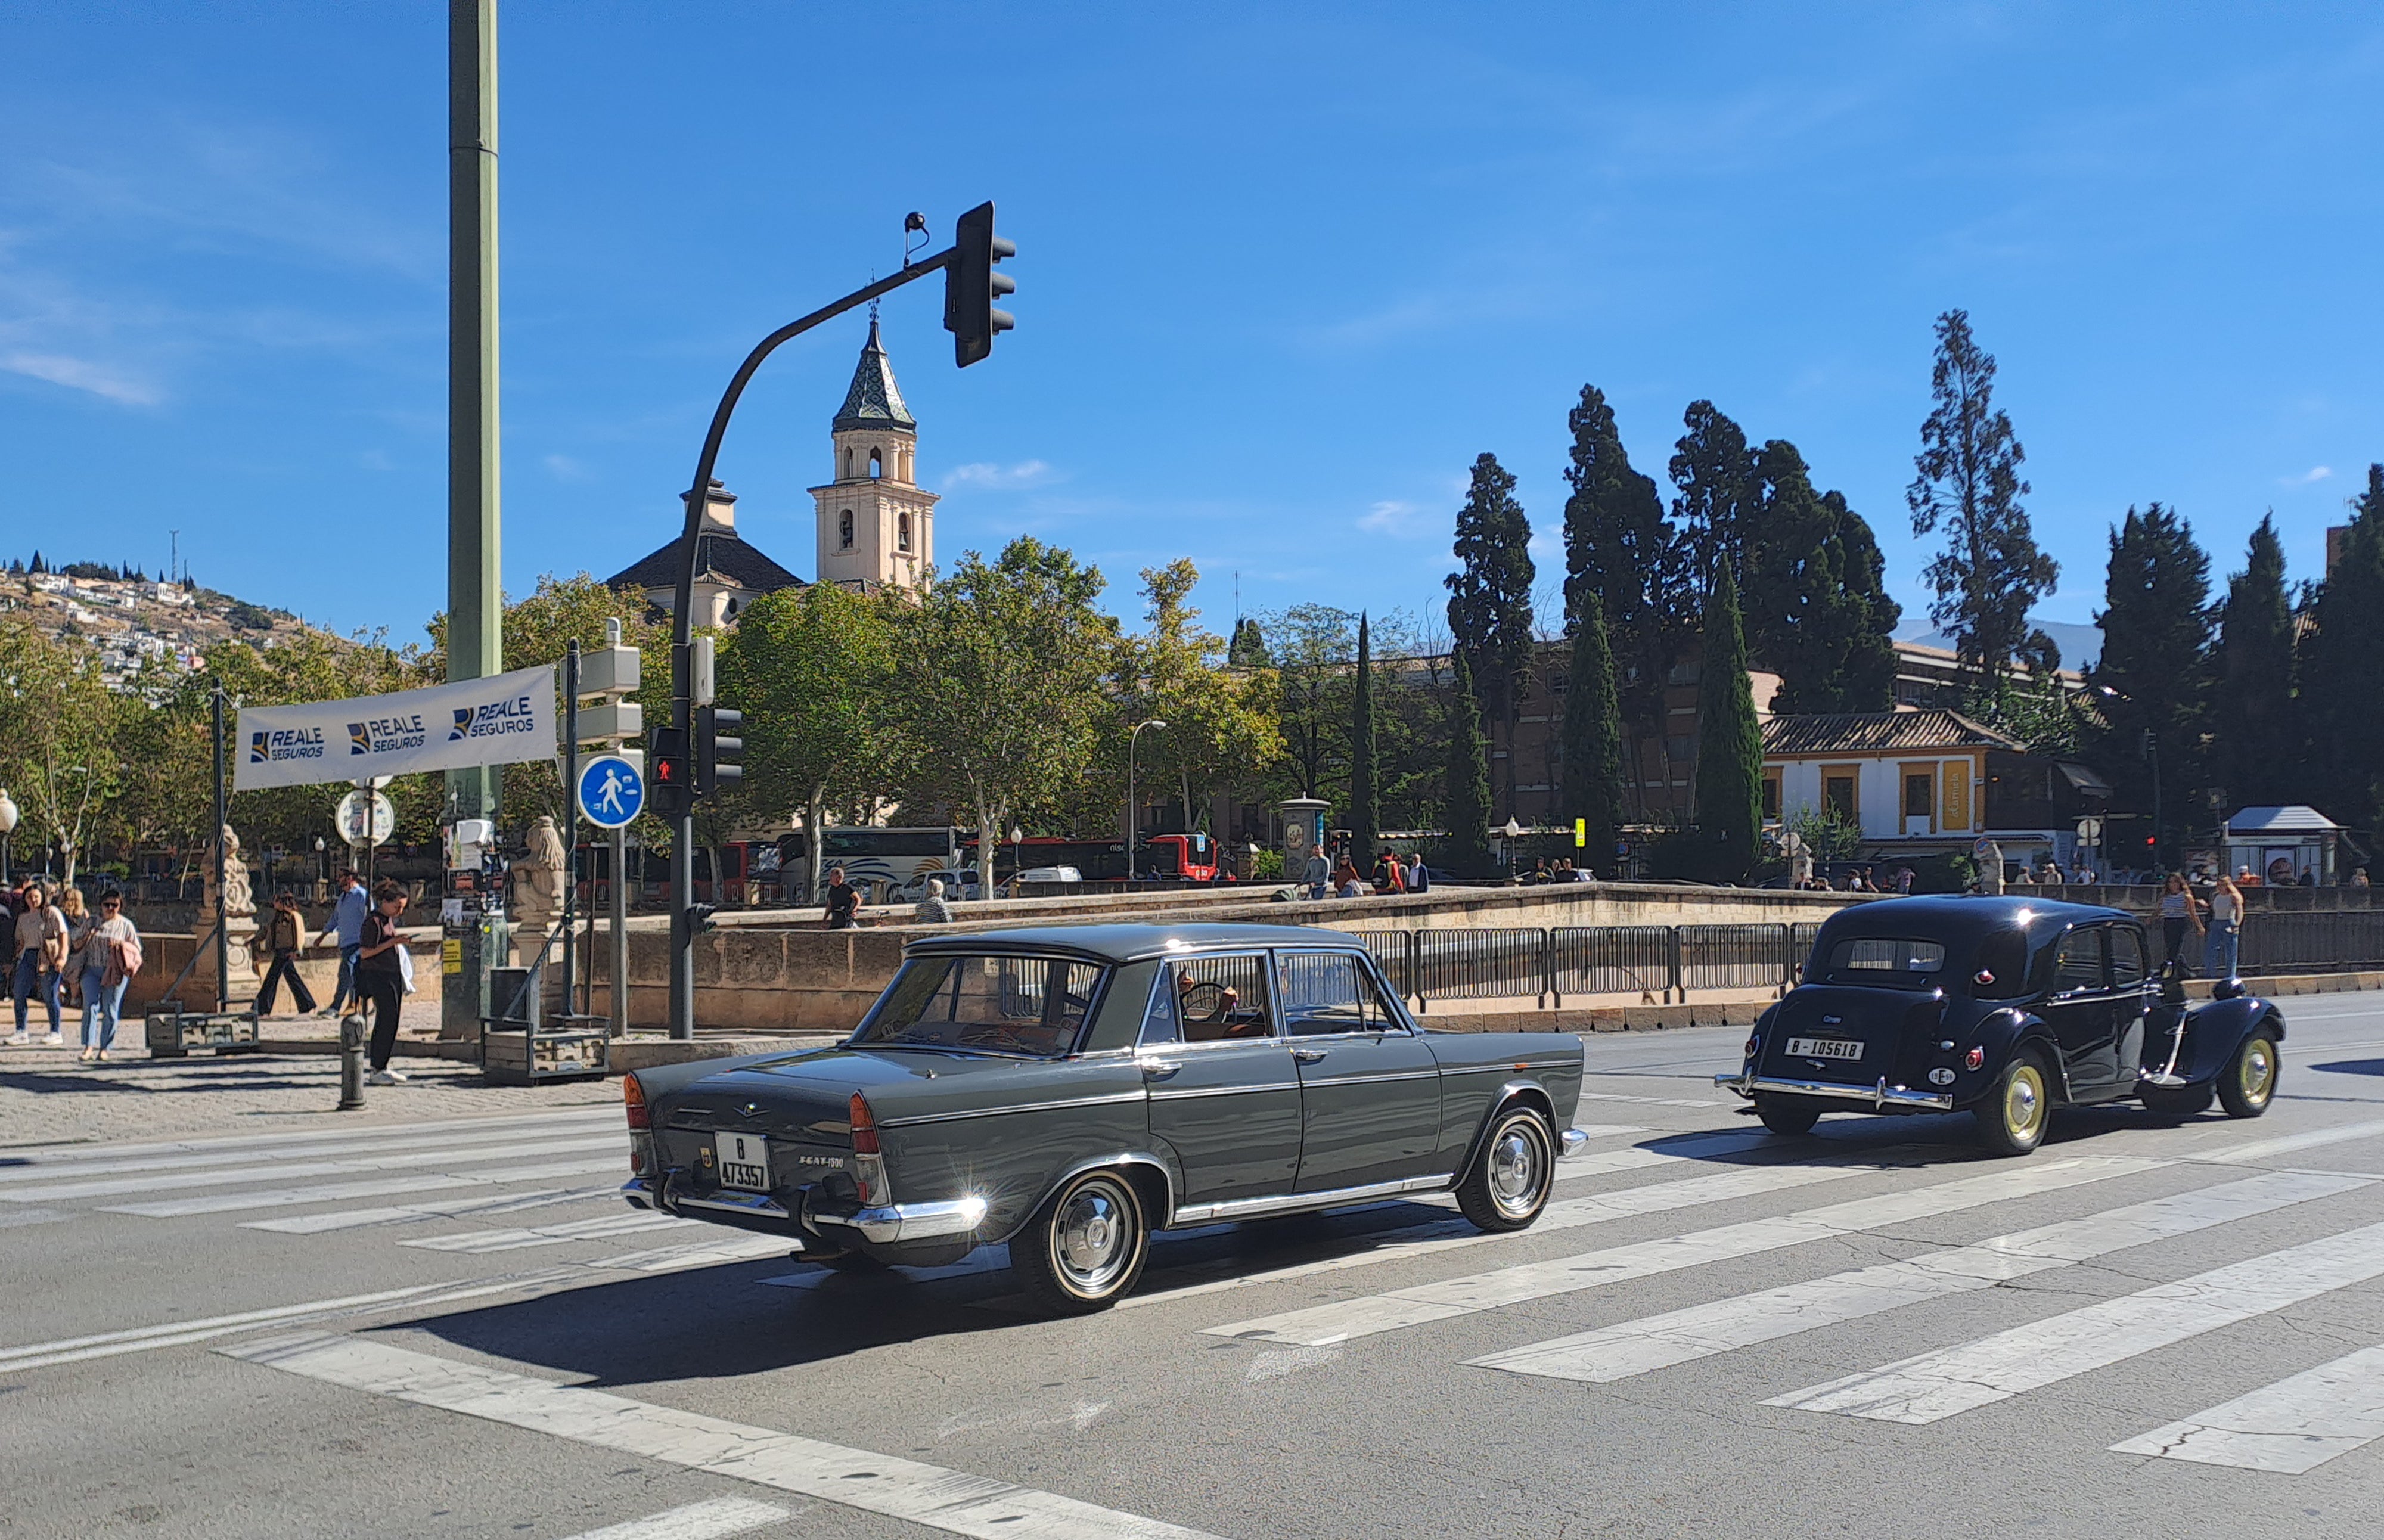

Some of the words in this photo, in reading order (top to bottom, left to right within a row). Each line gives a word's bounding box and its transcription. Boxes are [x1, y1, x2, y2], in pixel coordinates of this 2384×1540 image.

[475, 696, 532, 722] REALE
[368, 715, 425, 738] REALE
[470, 718, 533, 737] SEGUROS
[271, 727, 325, 747] REALE
[373, 735, 425, 752] SEGUROS
[272, 746, 324, 761] SEGUROS
[736, 1138, 745, 1159] B
[722, 1162, 764, 1187] 473357
